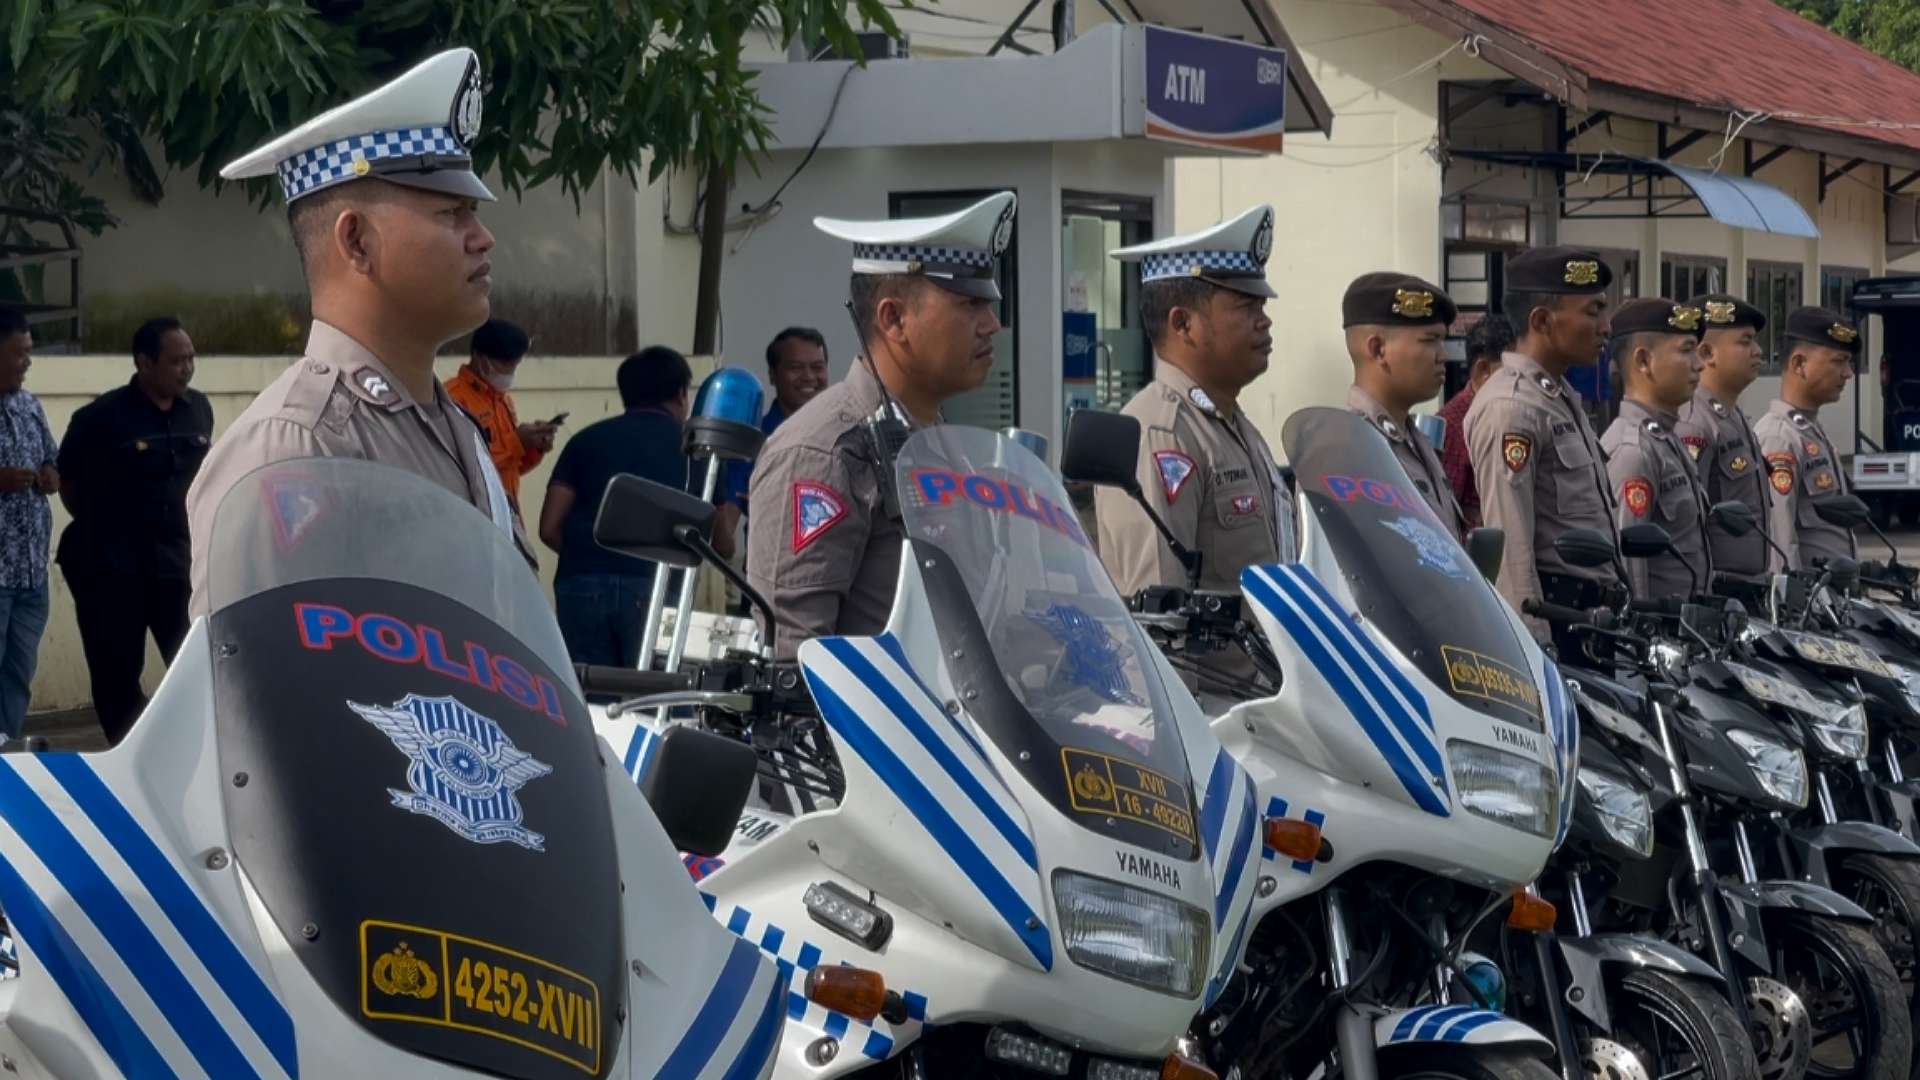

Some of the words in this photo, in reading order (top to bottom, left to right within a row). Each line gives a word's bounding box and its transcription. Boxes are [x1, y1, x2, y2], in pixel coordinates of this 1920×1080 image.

[1164, 63, 1206, 104] ATM
[294, 602, 568, 728] POLISI
[1493, 726, 1538, 752] YAMAHA
[1123, 793, 1142, 816] 16
[1116, 851, 1181, 890] YAMAHA
[455, 957, 593, 1050] 4252-XVII
